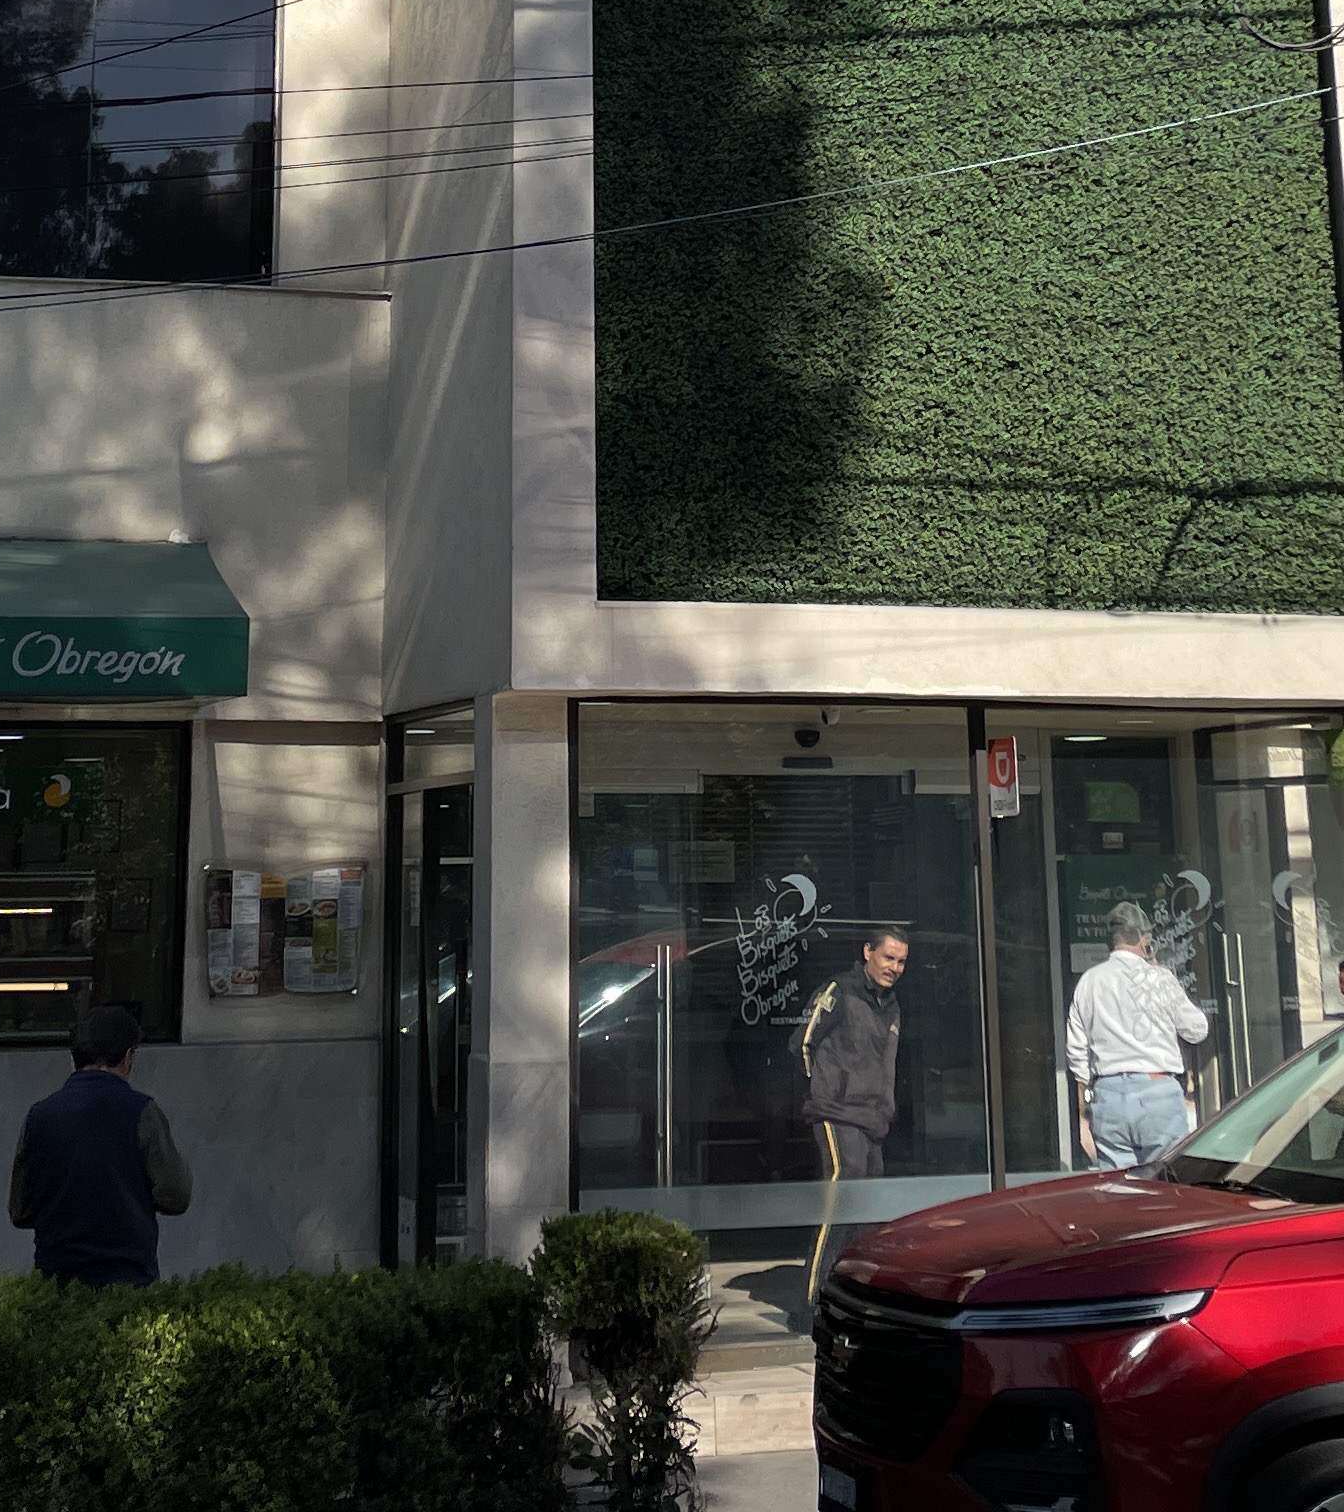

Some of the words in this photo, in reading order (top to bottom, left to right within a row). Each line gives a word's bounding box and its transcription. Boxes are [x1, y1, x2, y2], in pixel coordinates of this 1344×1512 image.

[12, 630, 186, 684] Obregón
[736, 914, 799, 968] Bisquets
[737, 942, 799, 997] Bisquets
[741, 979, 799, 1025] Obregón
